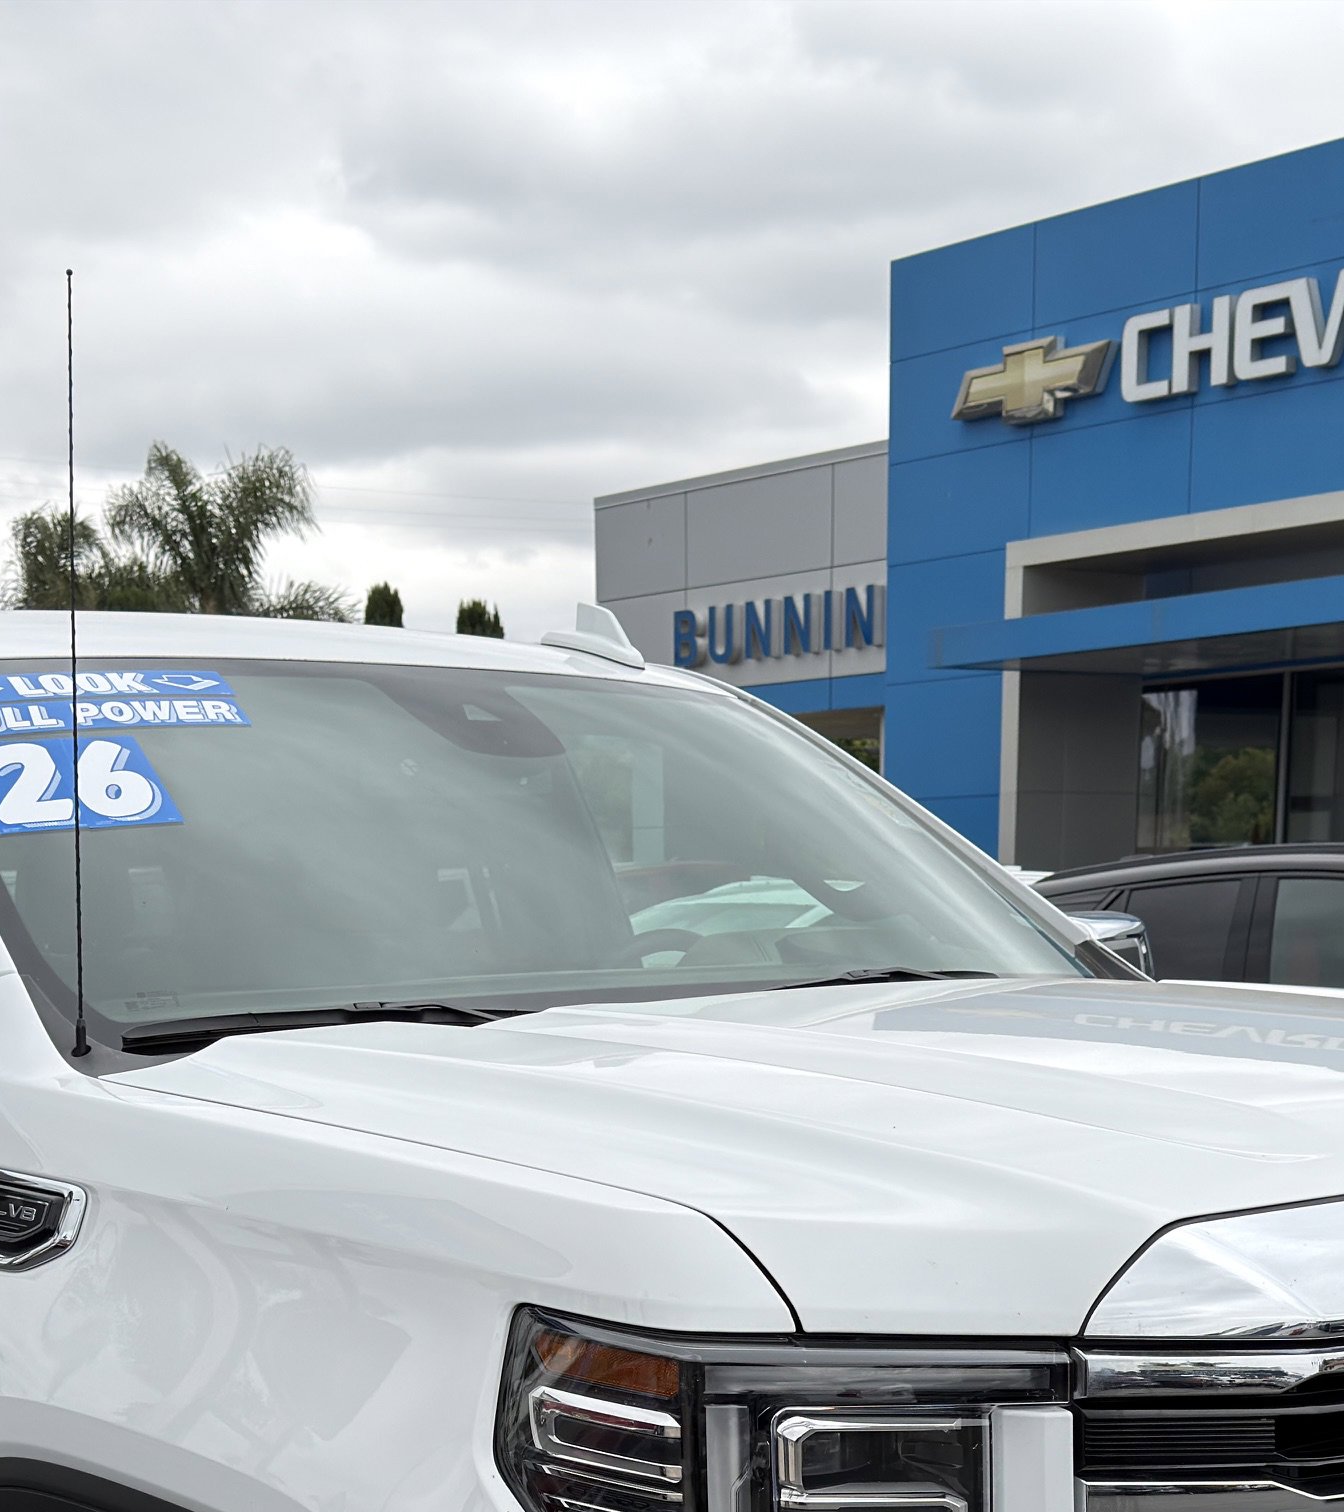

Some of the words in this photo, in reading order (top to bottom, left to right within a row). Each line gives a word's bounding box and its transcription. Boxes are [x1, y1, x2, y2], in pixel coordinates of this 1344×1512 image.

[673, 584, 884, 668] BUNNIN
[7, 672, 155, 697] LOOK
[70, 699, 242, 726] POWER
